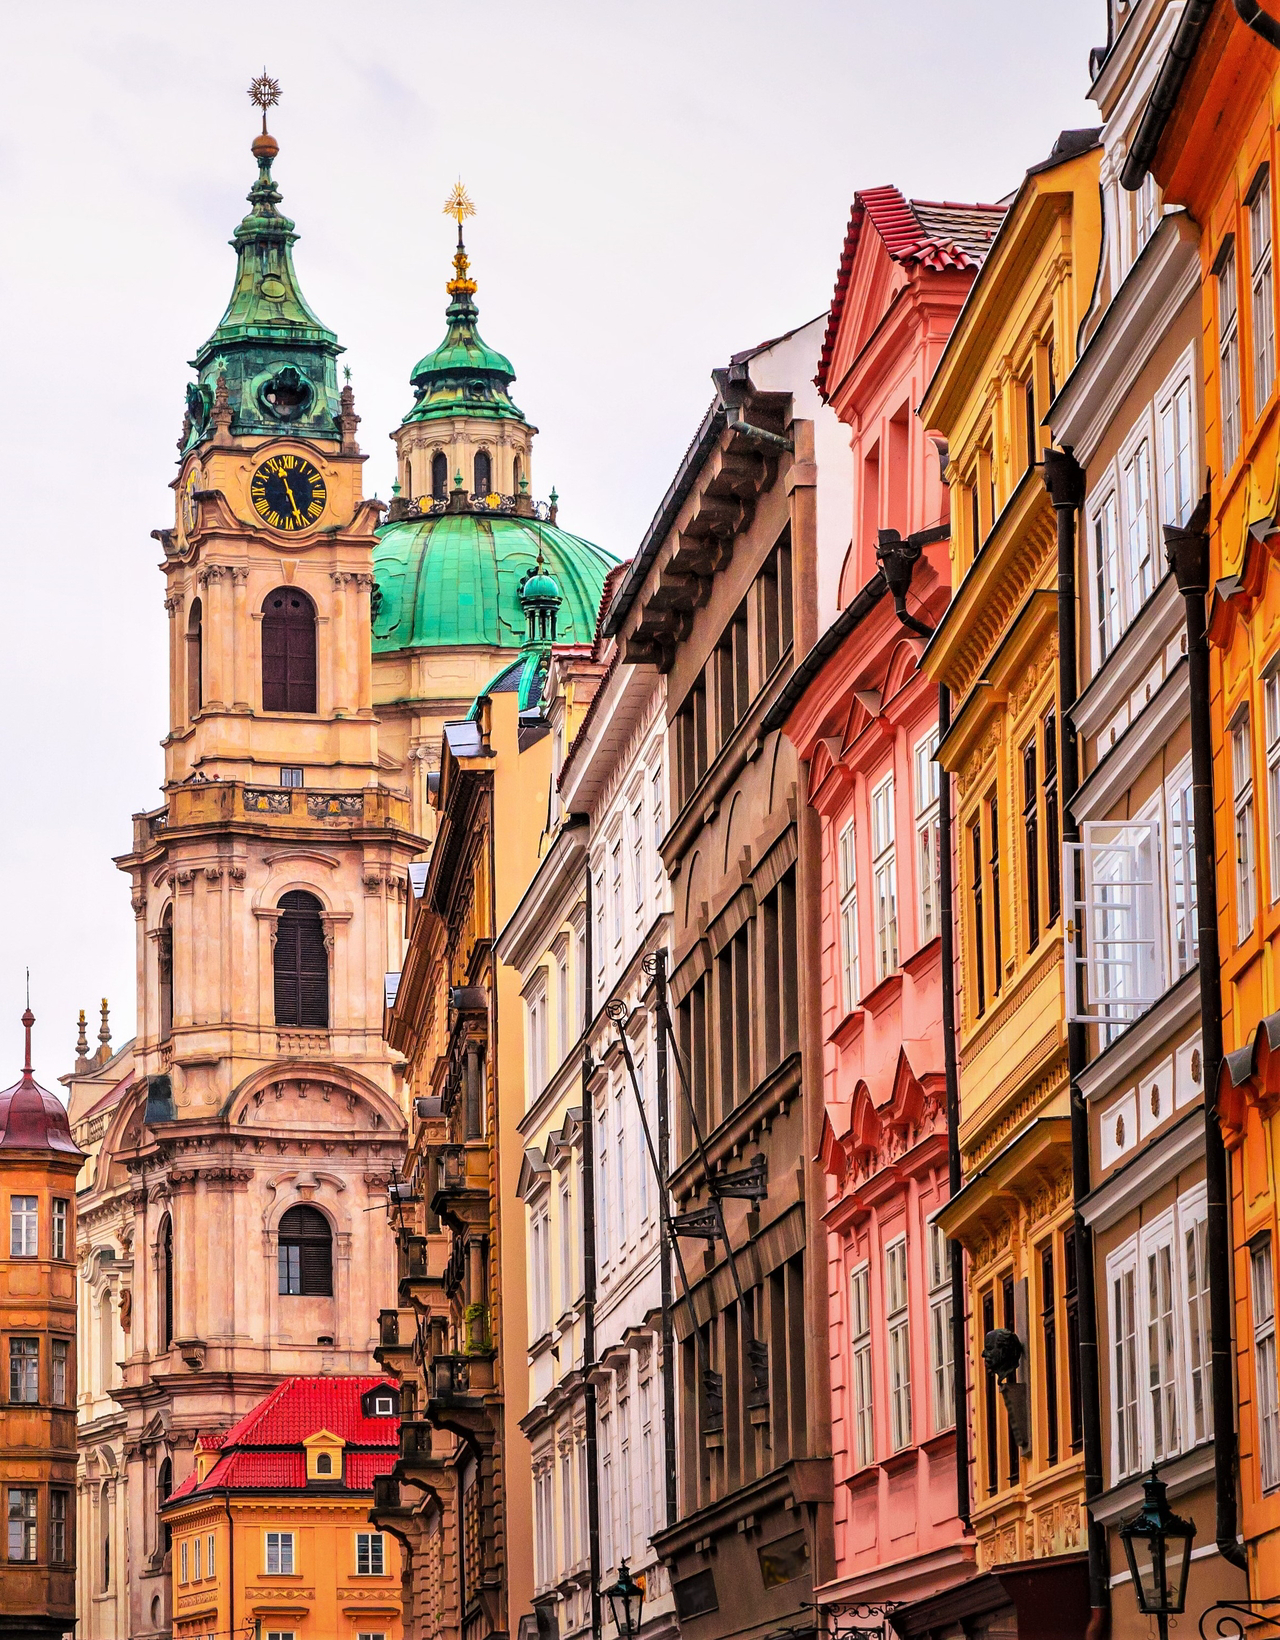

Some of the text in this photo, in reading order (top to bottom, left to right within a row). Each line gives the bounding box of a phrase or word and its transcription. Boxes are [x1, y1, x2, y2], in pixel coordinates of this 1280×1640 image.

[266, 458, 279, 473] XI
[282, 456, 294, 469] XII
[255, 470, 269, 482] X
[308, 473, 321, 483] II
[312, 489, 325, 499] III
